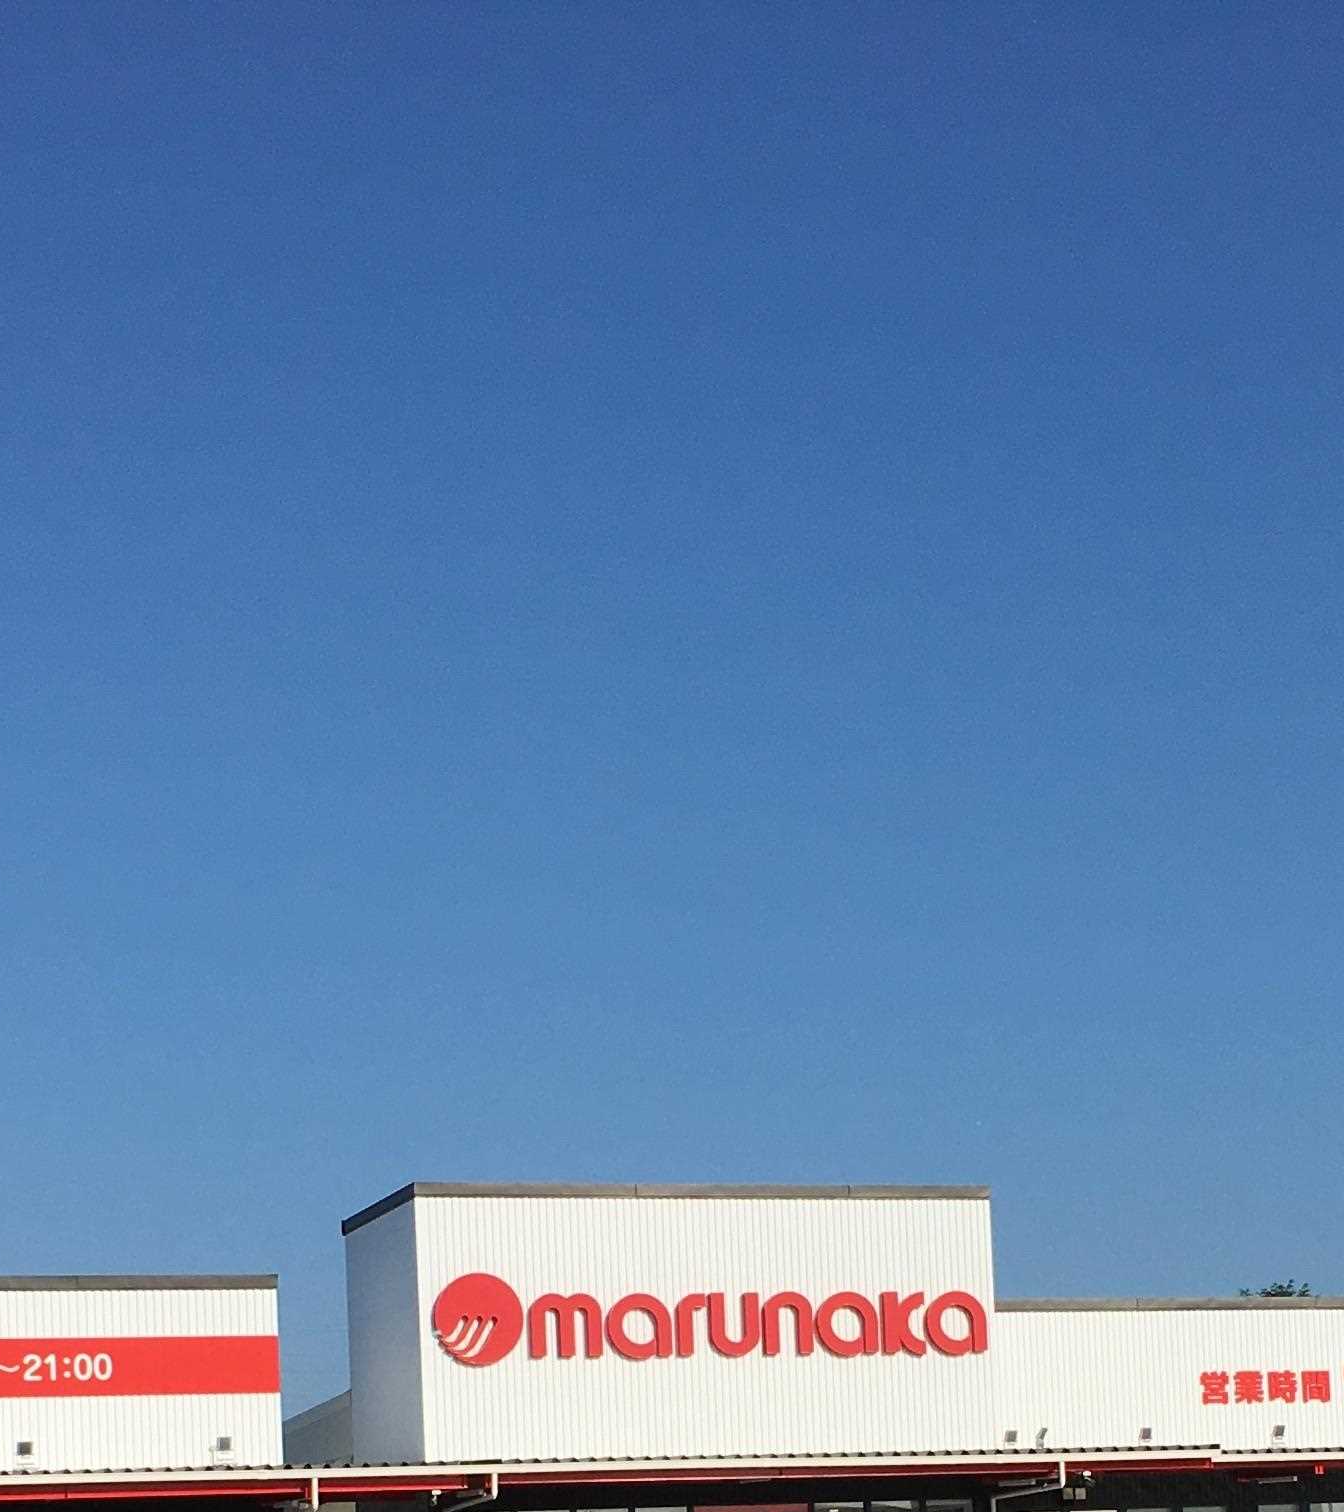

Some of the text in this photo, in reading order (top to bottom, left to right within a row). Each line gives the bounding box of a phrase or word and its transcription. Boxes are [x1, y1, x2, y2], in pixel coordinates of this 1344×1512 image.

[527, 1290, 988, 1359] marunaka
[1199, 1370, 1331, 1405] 営業時間
